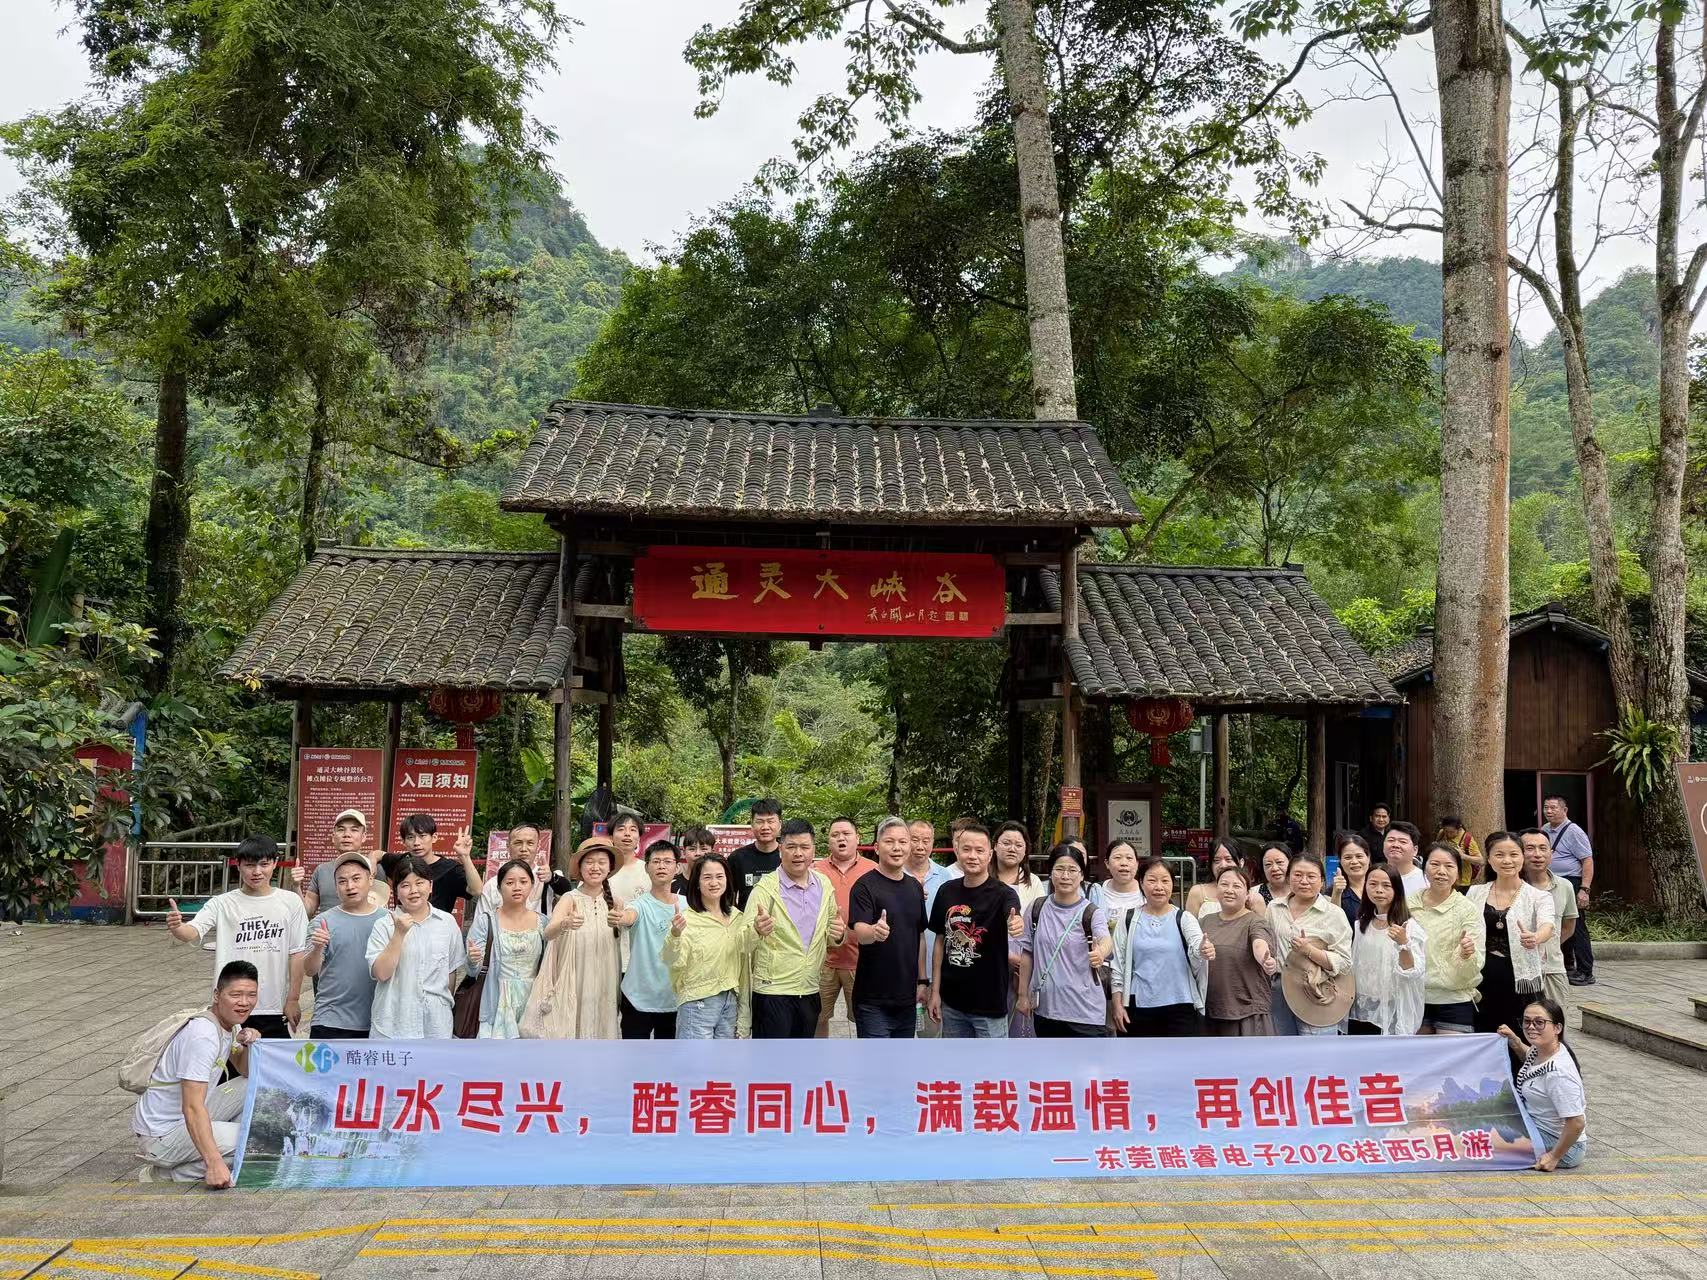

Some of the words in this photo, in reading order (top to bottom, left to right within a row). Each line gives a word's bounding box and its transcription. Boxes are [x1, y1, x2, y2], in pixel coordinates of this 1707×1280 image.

[399, 772, 469, 789] 入园须知
[239, 920, 269, 931] THEY
[235, 928, 285, 942] DILIGENT
[346, 1049, 413, 1066] 酷睿电子
[334, 1078, 589, 1136] 山水尽兴，
[631, 1080, 875, 1135] 酷睿同心，
[916, 1078, 1156, 1135] 满载温情，
[1194, 1073, 1407, 1129] 再创佳音
